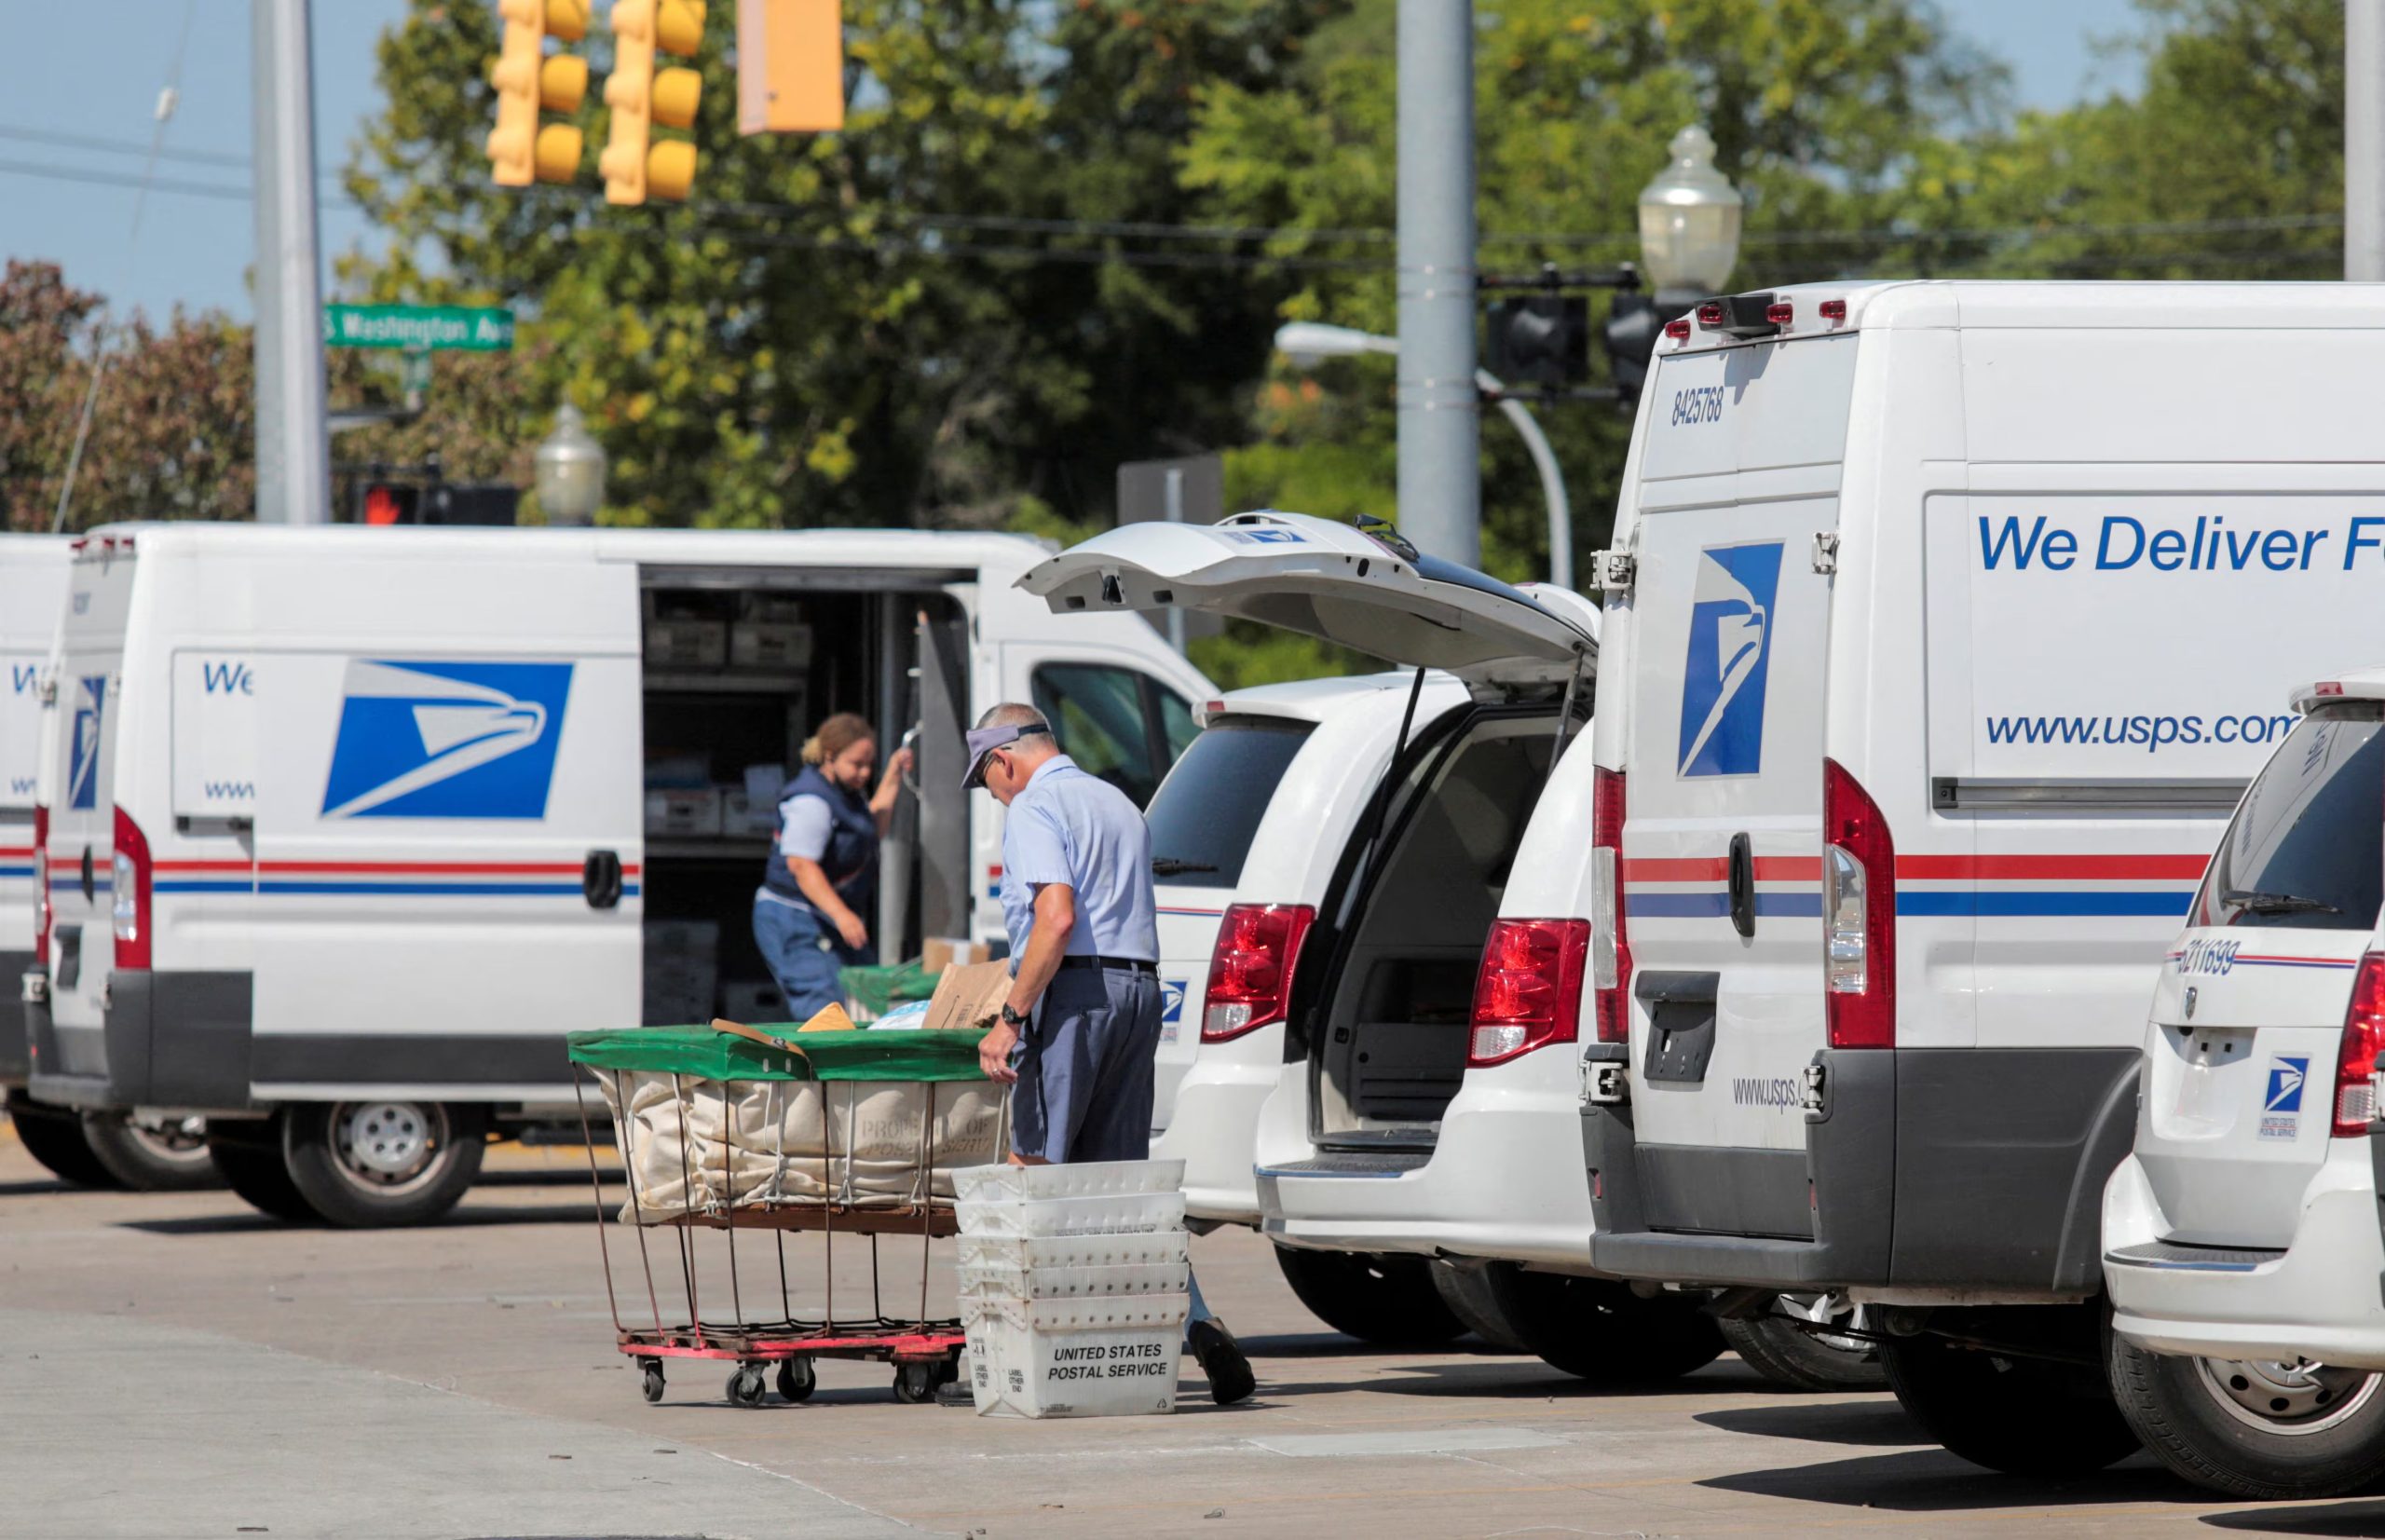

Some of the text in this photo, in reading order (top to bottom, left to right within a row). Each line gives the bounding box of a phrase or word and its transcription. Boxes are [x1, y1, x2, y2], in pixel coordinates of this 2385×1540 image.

[342, 312, 469, 346] Washington
[1672, 385, 1724, 427] 8425768
[1979, 515, 2385, 571] We Deliver F
[1733, 1078, 1801, 1115] www.usps.
[966, 1118, 990, 1135] OF
[1054, 1343, 1163, 1361] UNITED STATES
[1048, 1362, 1168, 1380] POSTAL SERVICE
